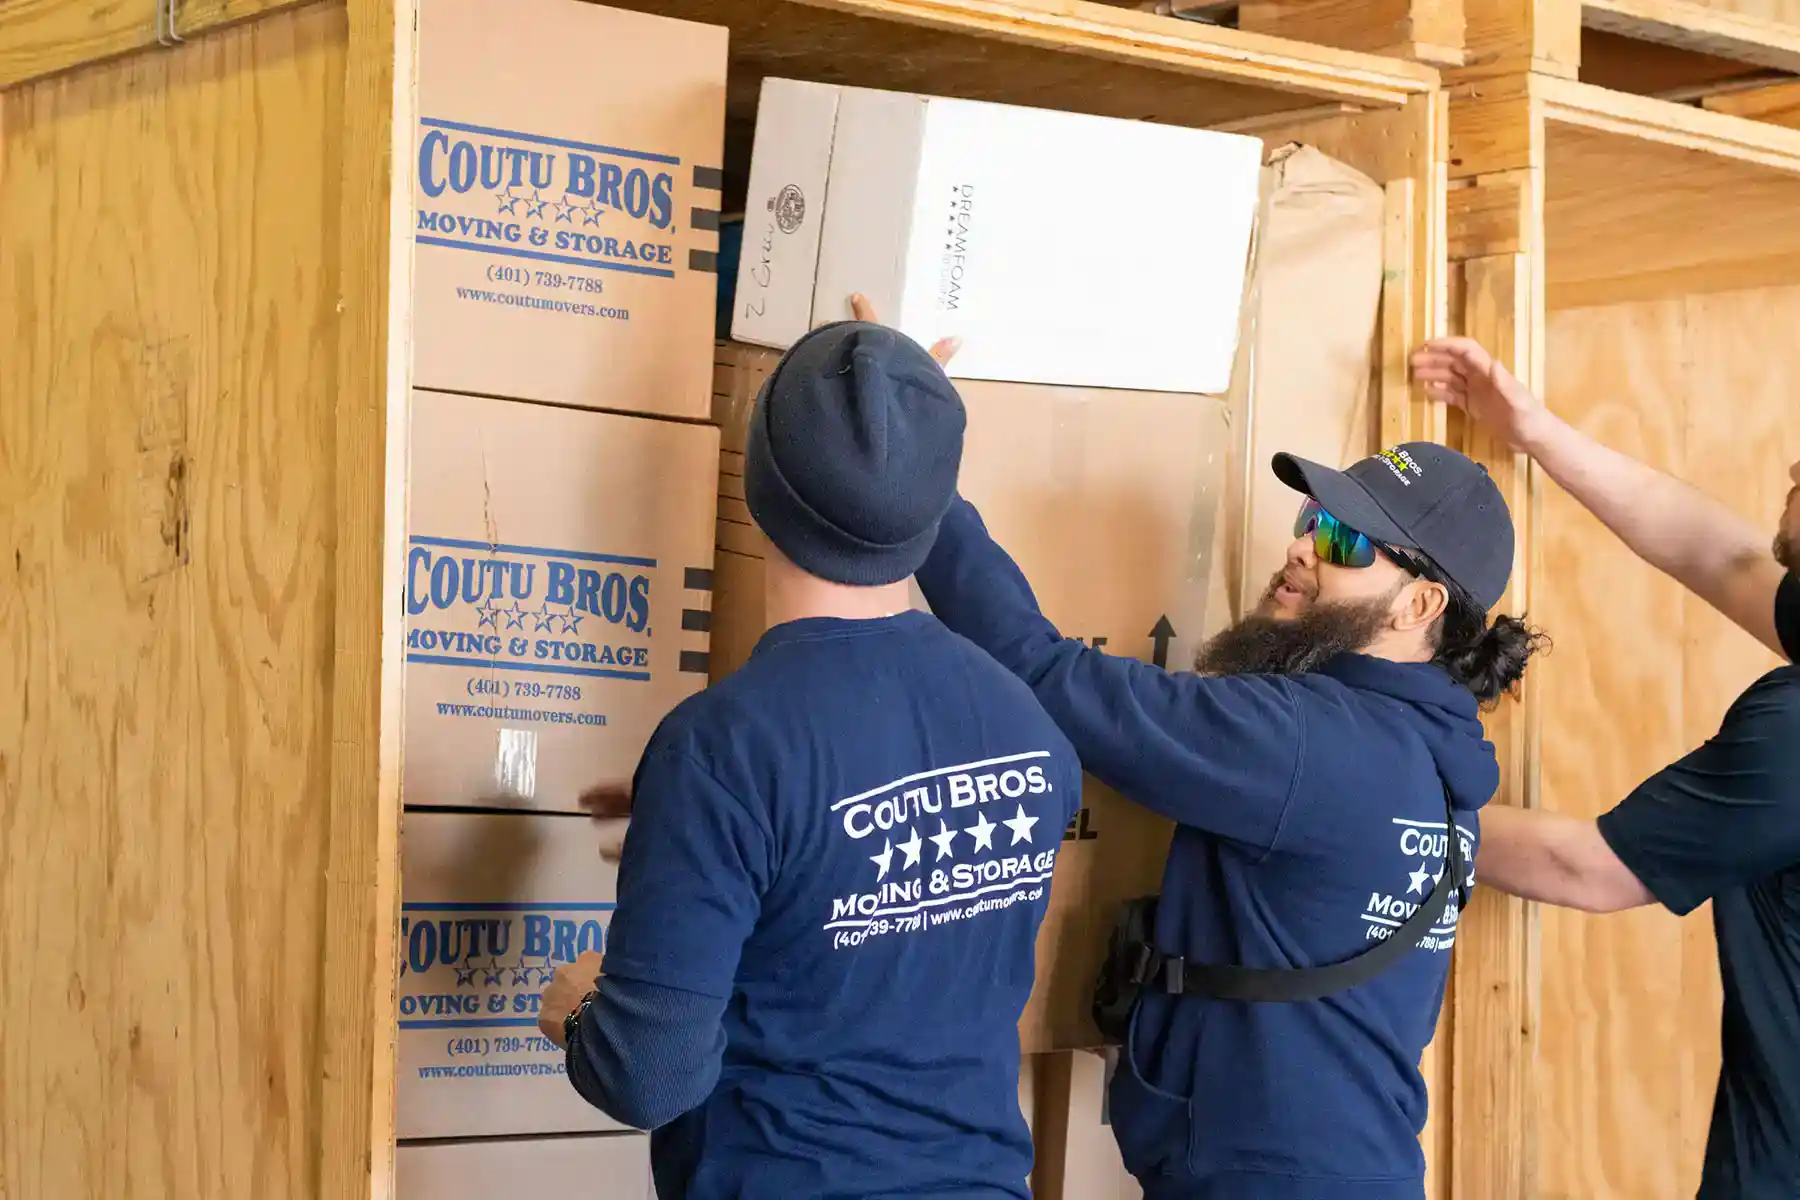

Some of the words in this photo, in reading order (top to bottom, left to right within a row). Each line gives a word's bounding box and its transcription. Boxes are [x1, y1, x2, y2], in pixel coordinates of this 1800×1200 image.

[418, 130, 556, 198] COUTU
[565, 153, 676, 234] BROS.
[417, 209, 521, 242] MOVING
[528, 227, 549, 246] &
[555, 231, 672, 264] STORAGE
[947, 184, 975, 311] DREAMFOAM
[486, 264, 530, 287] (401)
[535, 270, 603, 293] 739-7788
[456, 287, 630, 320] www.coutumovers.com
[1399, 450, 1422, 477] BROS.
[407, 546, 536, 615] COUTU
[546, 560, 652, 637] BROS.
[508, 636, 527, 657] &
[534, 640, 649, 667] STORAGE
[467, 677, 510, 698] (401)
[514, 681, 581, 701] 739-7788
[436, 702, 607, 726] www.coutumovers.com
[843, 784, 943, 840] COUTU
[948, 765, 1053, 809] BROS.
[929, 869, 950, 895] &
[952, 848, 1055, 889] STORAGE
[401, 917, 512, 979] OUTU
[400, 994, 481, 1015] OVING
[487, 994, 507, 1014] &
[447, 1038, 490, 1056] (401)
